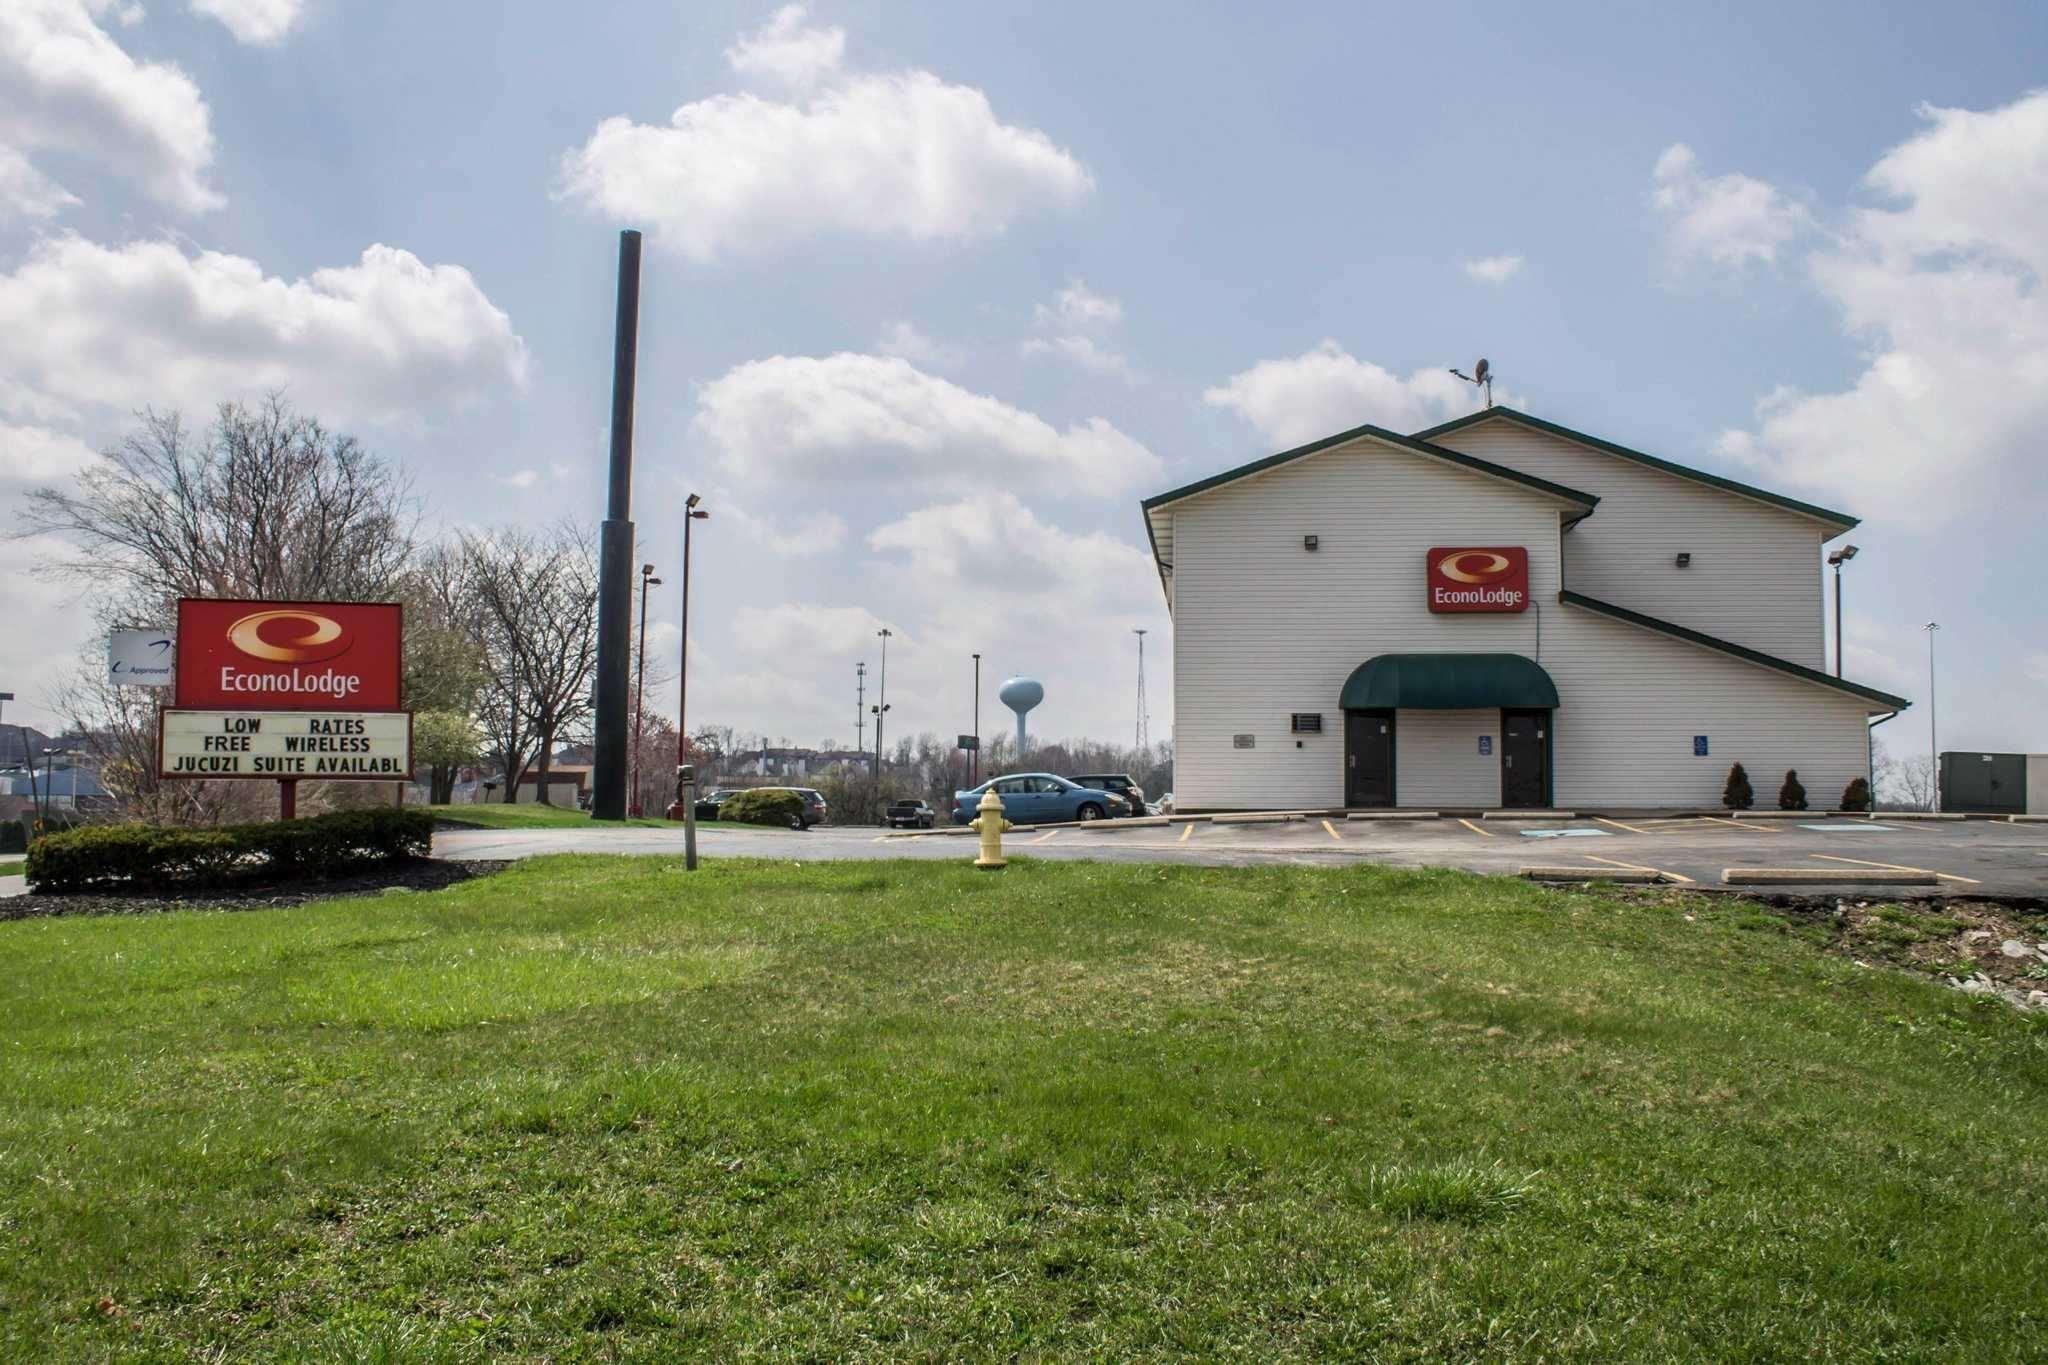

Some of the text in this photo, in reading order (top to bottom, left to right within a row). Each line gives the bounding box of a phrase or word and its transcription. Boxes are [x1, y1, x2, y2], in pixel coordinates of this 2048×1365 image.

[1434, 587, 1522, 606] EconoLodge
[130, 666, 169, 675] Approved
[221, 667, 360, 698] EconoLodge
[224, 718, 364, 734] LOW RATES
[205, 736, 370, 752] FREE WIRELESS
[173, 757, 402, 773] JUCUZI SUITE AVAILABL
